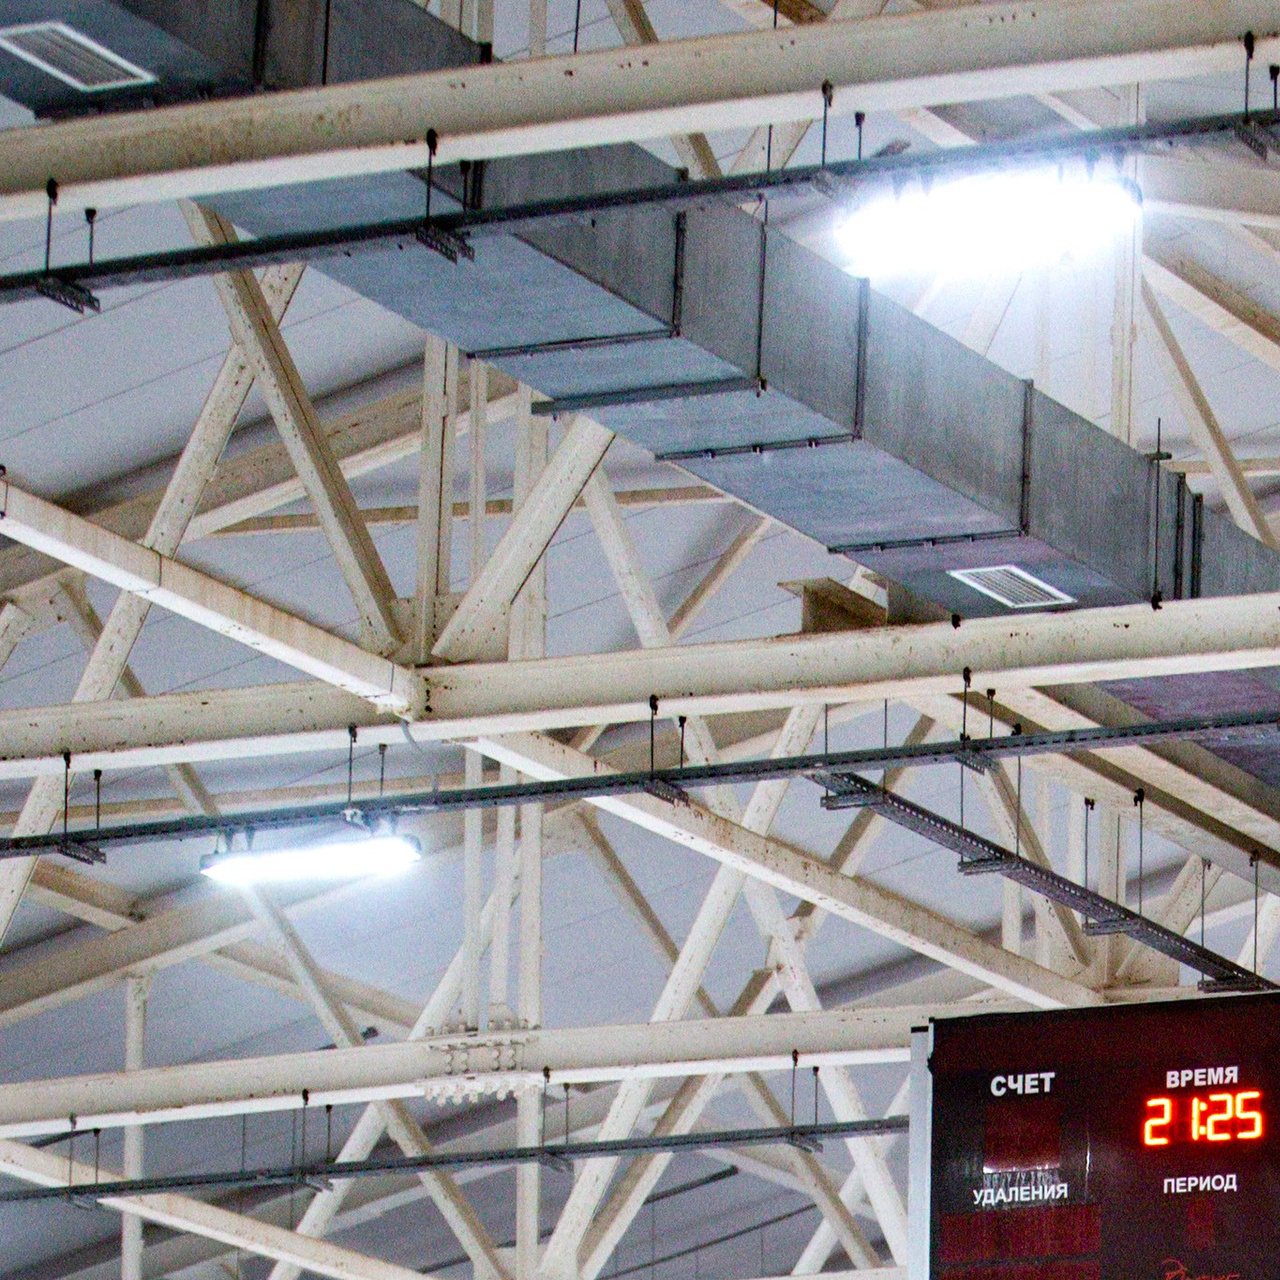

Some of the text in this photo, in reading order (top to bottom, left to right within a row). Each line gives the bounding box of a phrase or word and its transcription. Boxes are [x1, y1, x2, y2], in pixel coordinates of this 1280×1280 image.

[990, 1072, 1056, 1097] СЧЕТ
[1166, 1066, 1239, 1088] ВРЕМЯ
[1143, 1091, 1263, 1147] 21:25
[973, 1182, 1069, 1205] УДАЛЕНИЯ
[1163, 1174, 1238, 1194] ПЕРИОД
